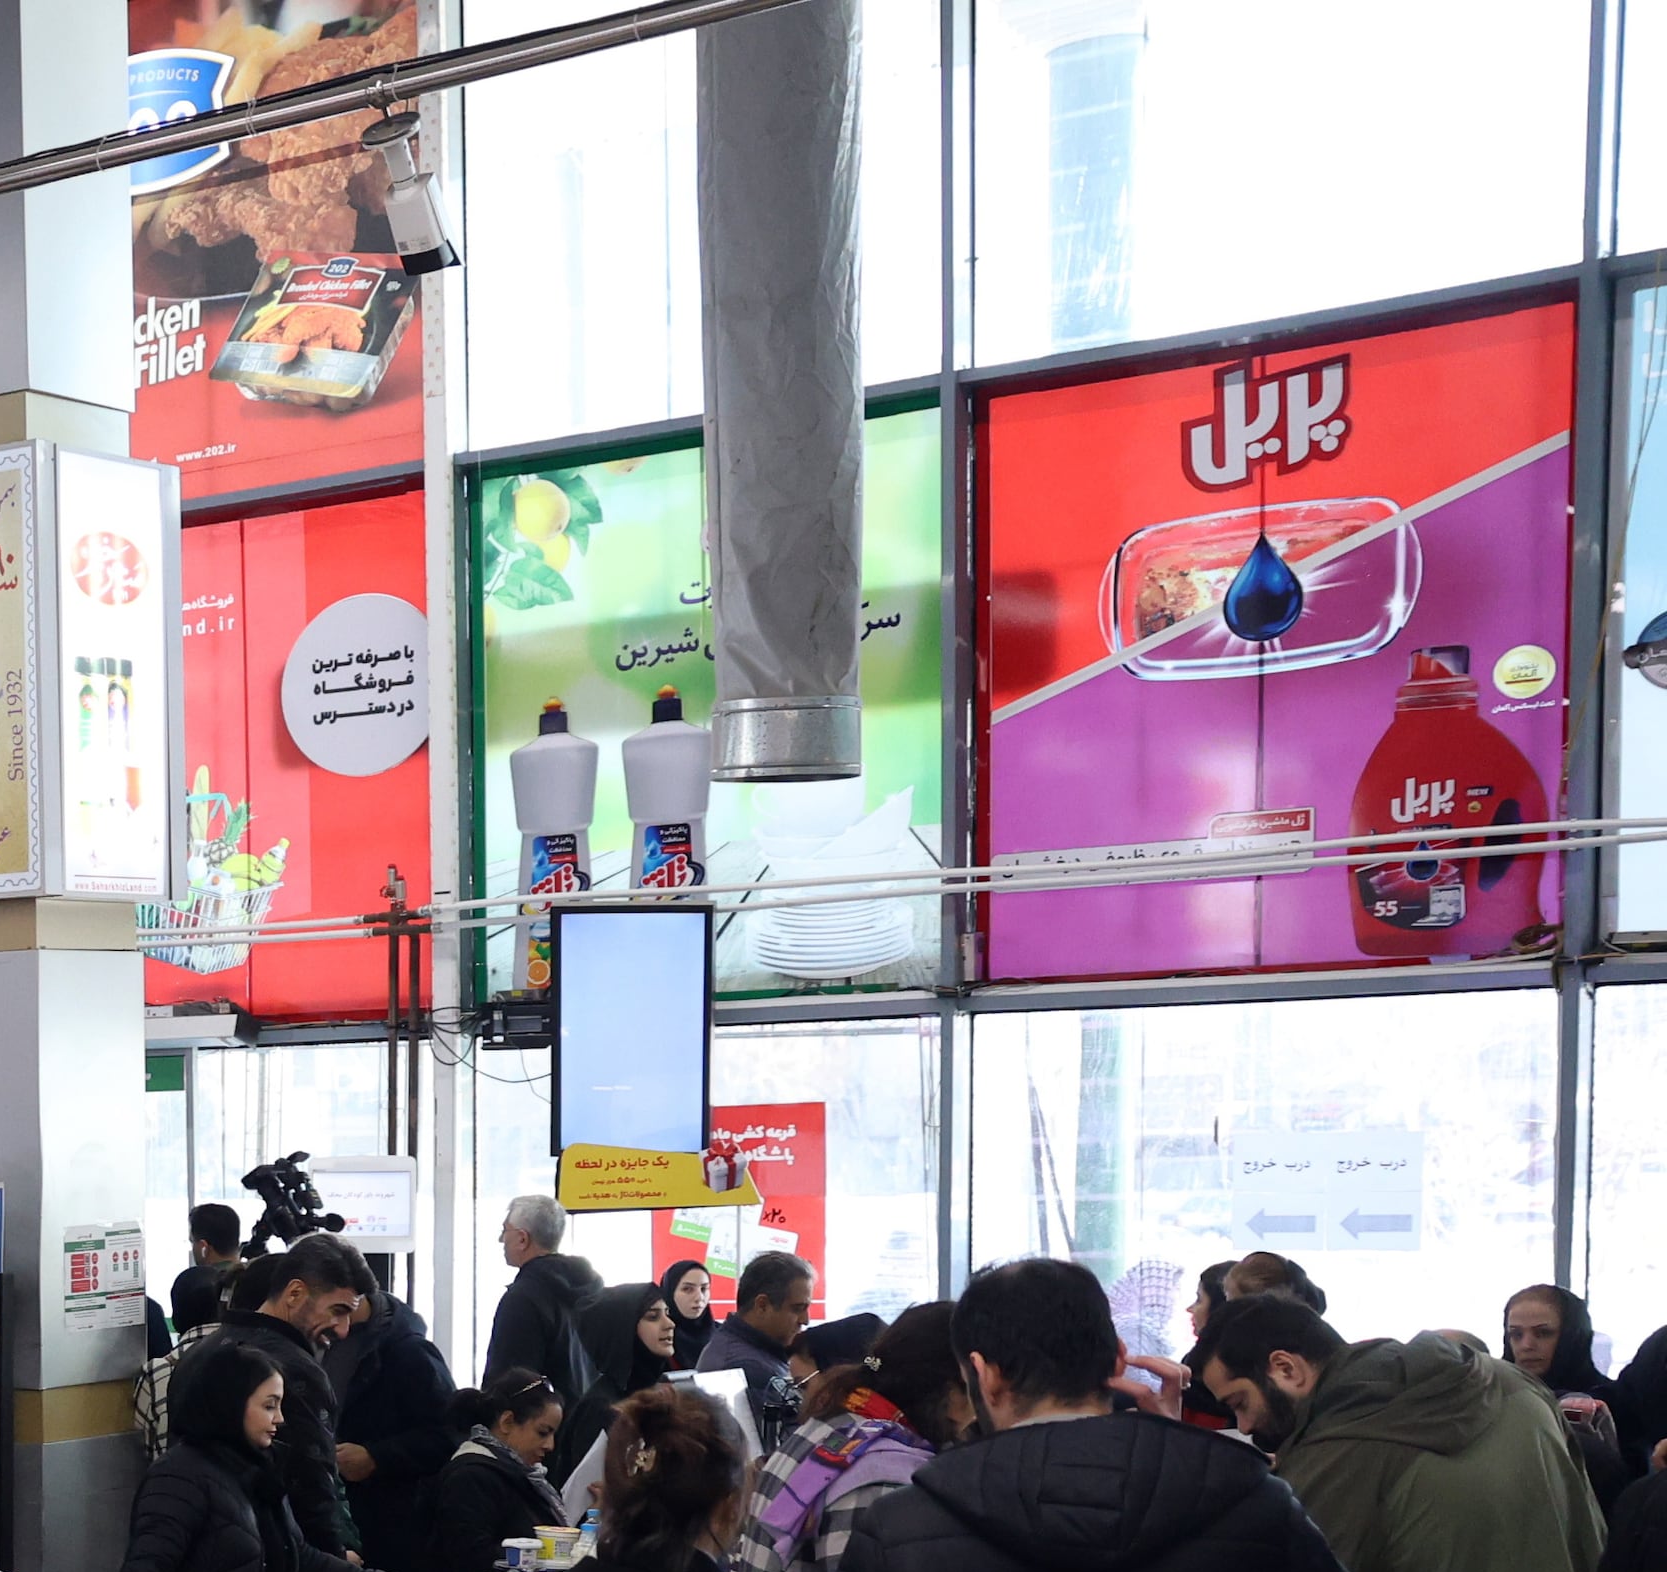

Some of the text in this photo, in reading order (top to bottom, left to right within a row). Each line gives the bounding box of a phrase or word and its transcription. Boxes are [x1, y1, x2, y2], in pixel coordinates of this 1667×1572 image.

[130, 67, 199, 84] PRODUCTS
[134, 296, 201, 346] cken
[134, 338, 207, 389] Fillet
[1190, 362, 1344, 484] پریل
[176, 443, 236, 463] www.202.ir
[183, 616, 235, 637] nd.ir
[312, 645, 415, 674] با صرفه ترین
[616, 626, 699, 670] شیرین
[313, 670, 415, 695] فروشگاه
[313, 699, 415, 725] در دسترس
[6, 668, 25, 782] Since 1932
[1391, 777, 1456, 823] پریل
[1374, 900, 1399, 917] 55
[732, 1125, 796, 1143] قرعه کشی
[575, 1156, 670, 1171] یک جایزه در لحظه
[1243, 1158, 1311, 1174] درب خروج
[1337, 1157, 1408, 1173] درب خروج
